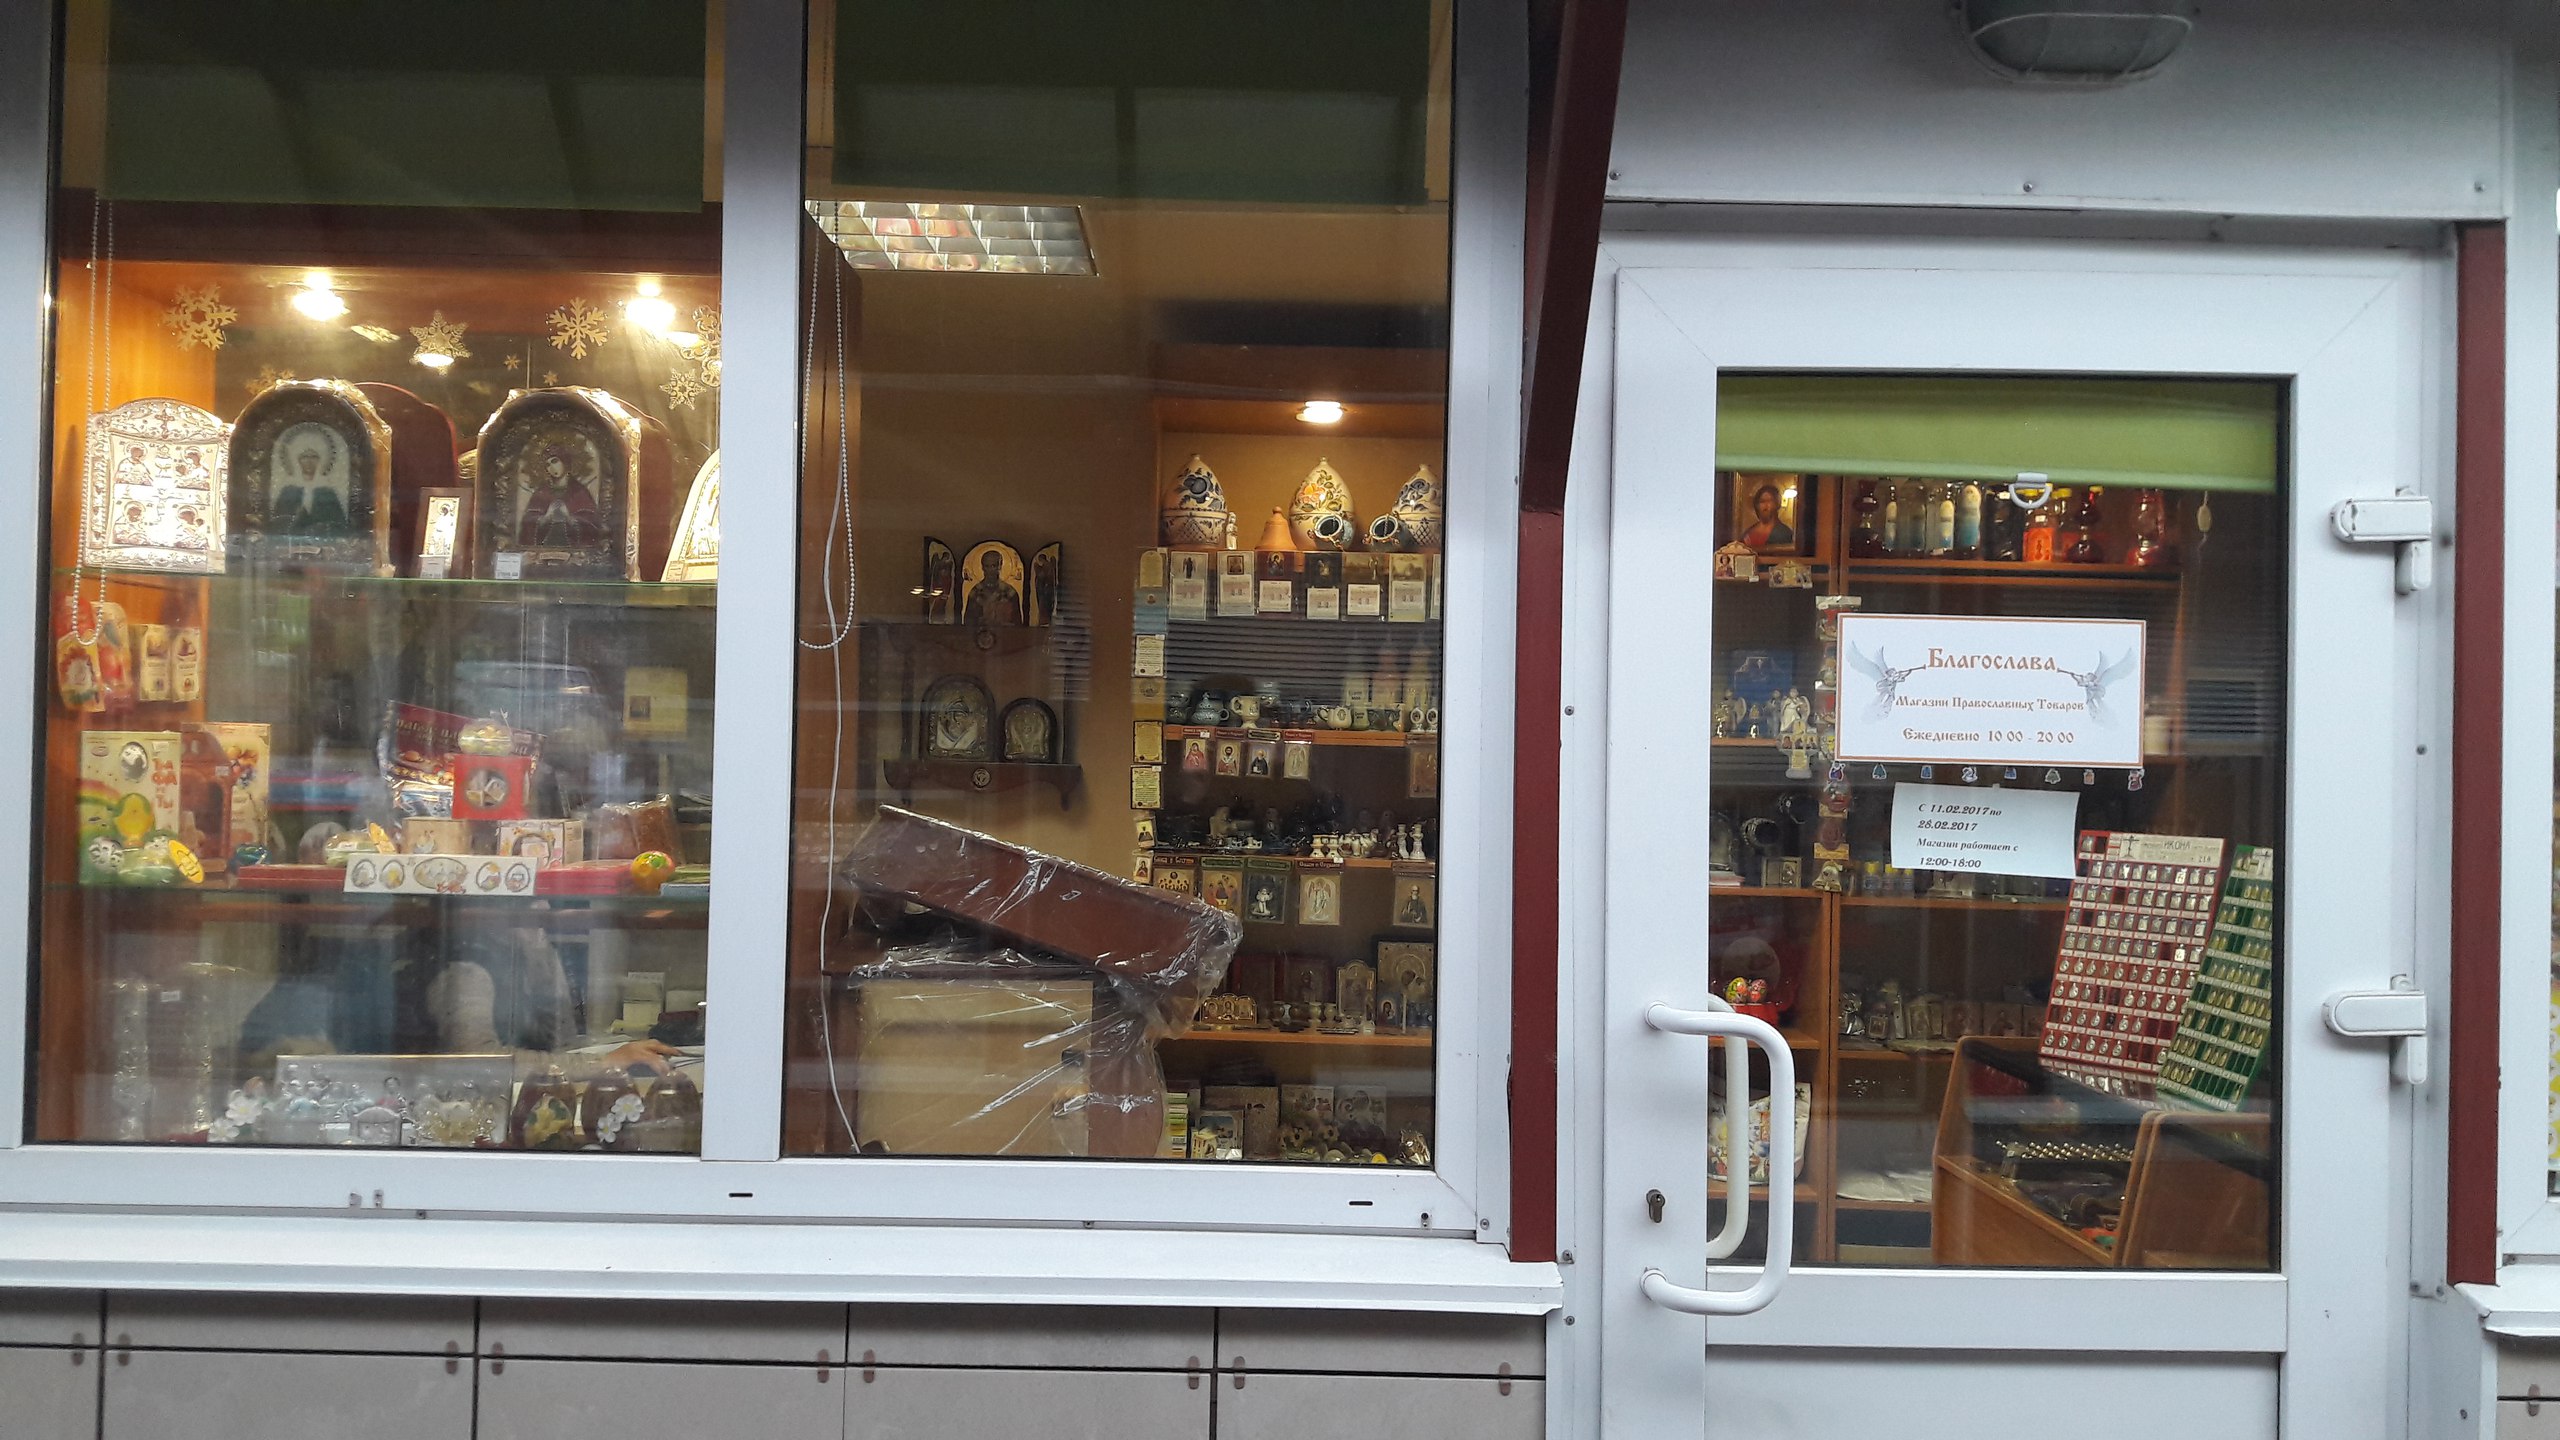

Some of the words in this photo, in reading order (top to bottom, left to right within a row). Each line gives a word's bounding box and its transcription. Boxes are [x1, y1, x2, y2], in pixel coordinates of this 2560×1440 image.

[1927, 647, 2056, 671] Благослава
[1895, 695, 1949, 708] Магазин
[1952, 696, 2034, 712] Православных
[2036, 698, 2084, 713] Товаров
[1918, 803, 1927, 812] С
[1930, 804, 1990, 816] 11.02.2017
[1917, 819, 1978, 832] 28.02.2017
[1916, 837, 1958, 849] Магазин
[1960, 840, 2011, 852] работает
[1919, 856, 1982, 869] 12:00-18:00
